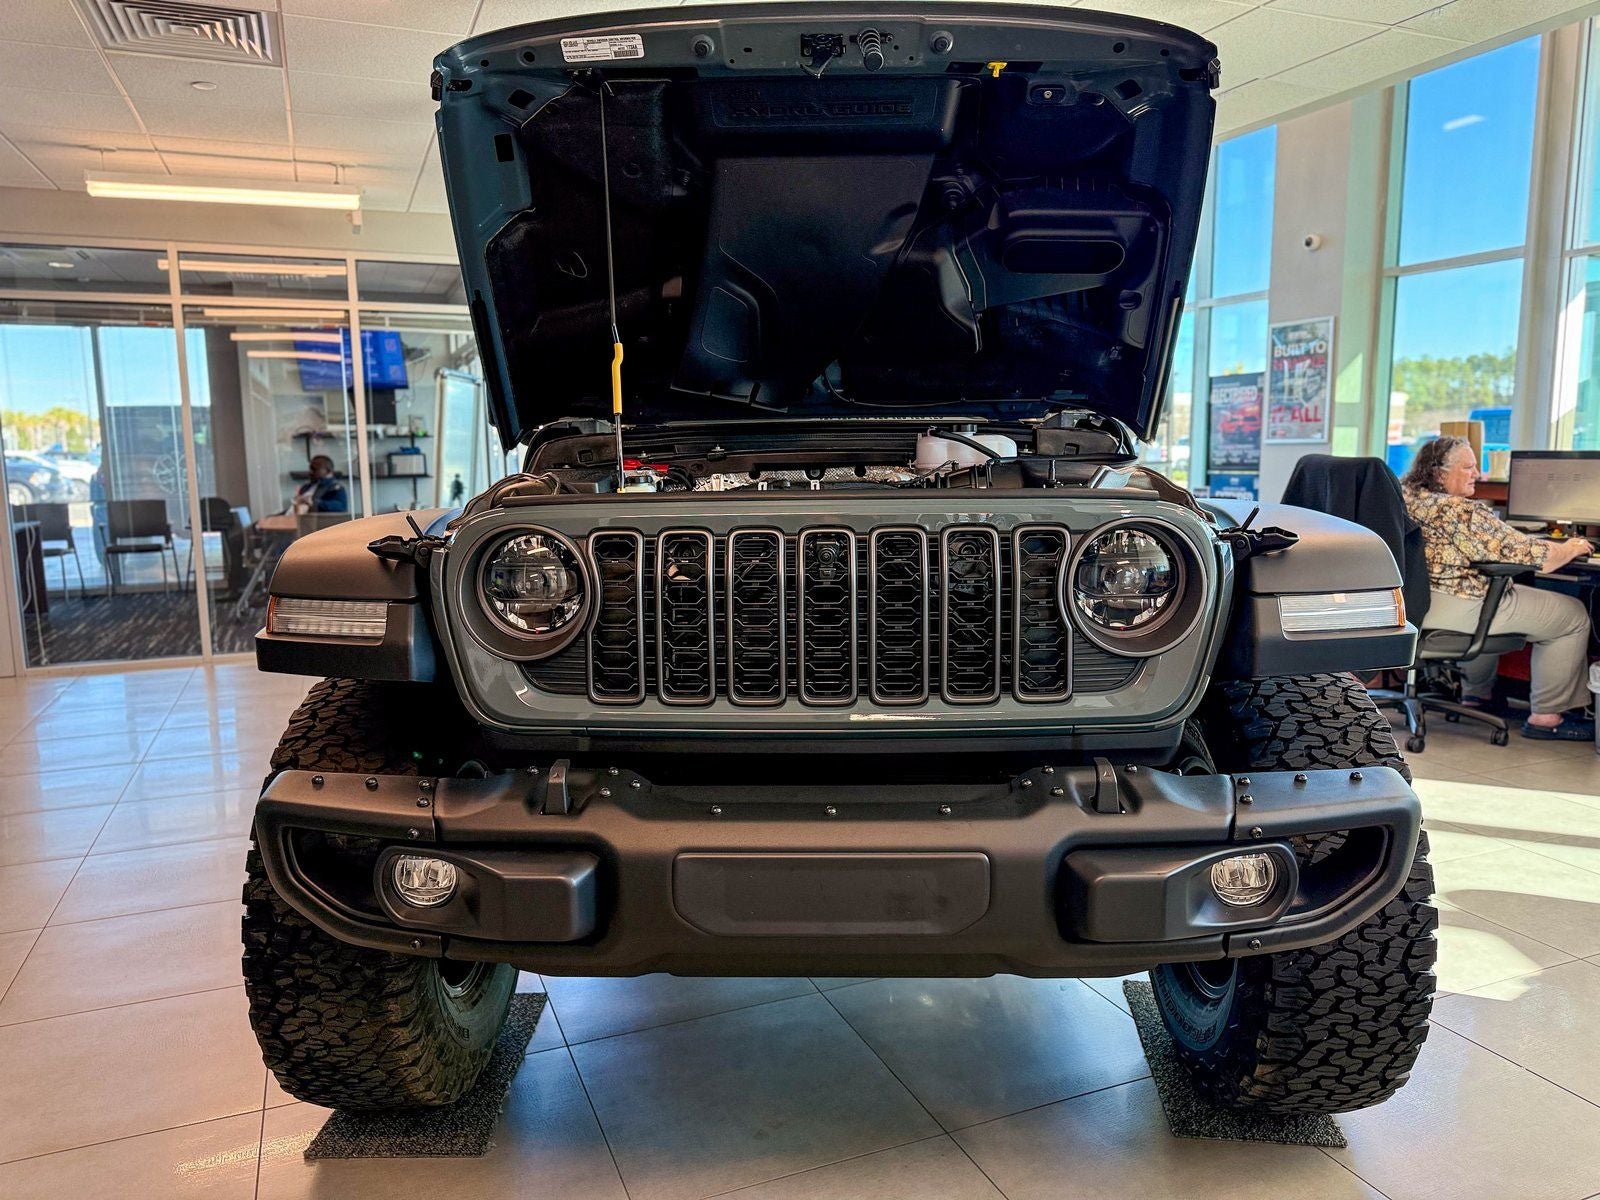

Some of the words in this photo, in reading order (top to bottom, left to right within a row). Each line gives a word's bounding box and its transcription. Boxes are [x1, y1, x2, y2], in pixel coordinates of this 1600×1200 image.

[1274, 343, 1307, 358] BUILT
[1308, 340, 1327, 355] TO
[1290, 405, 1322, 423] ALL
